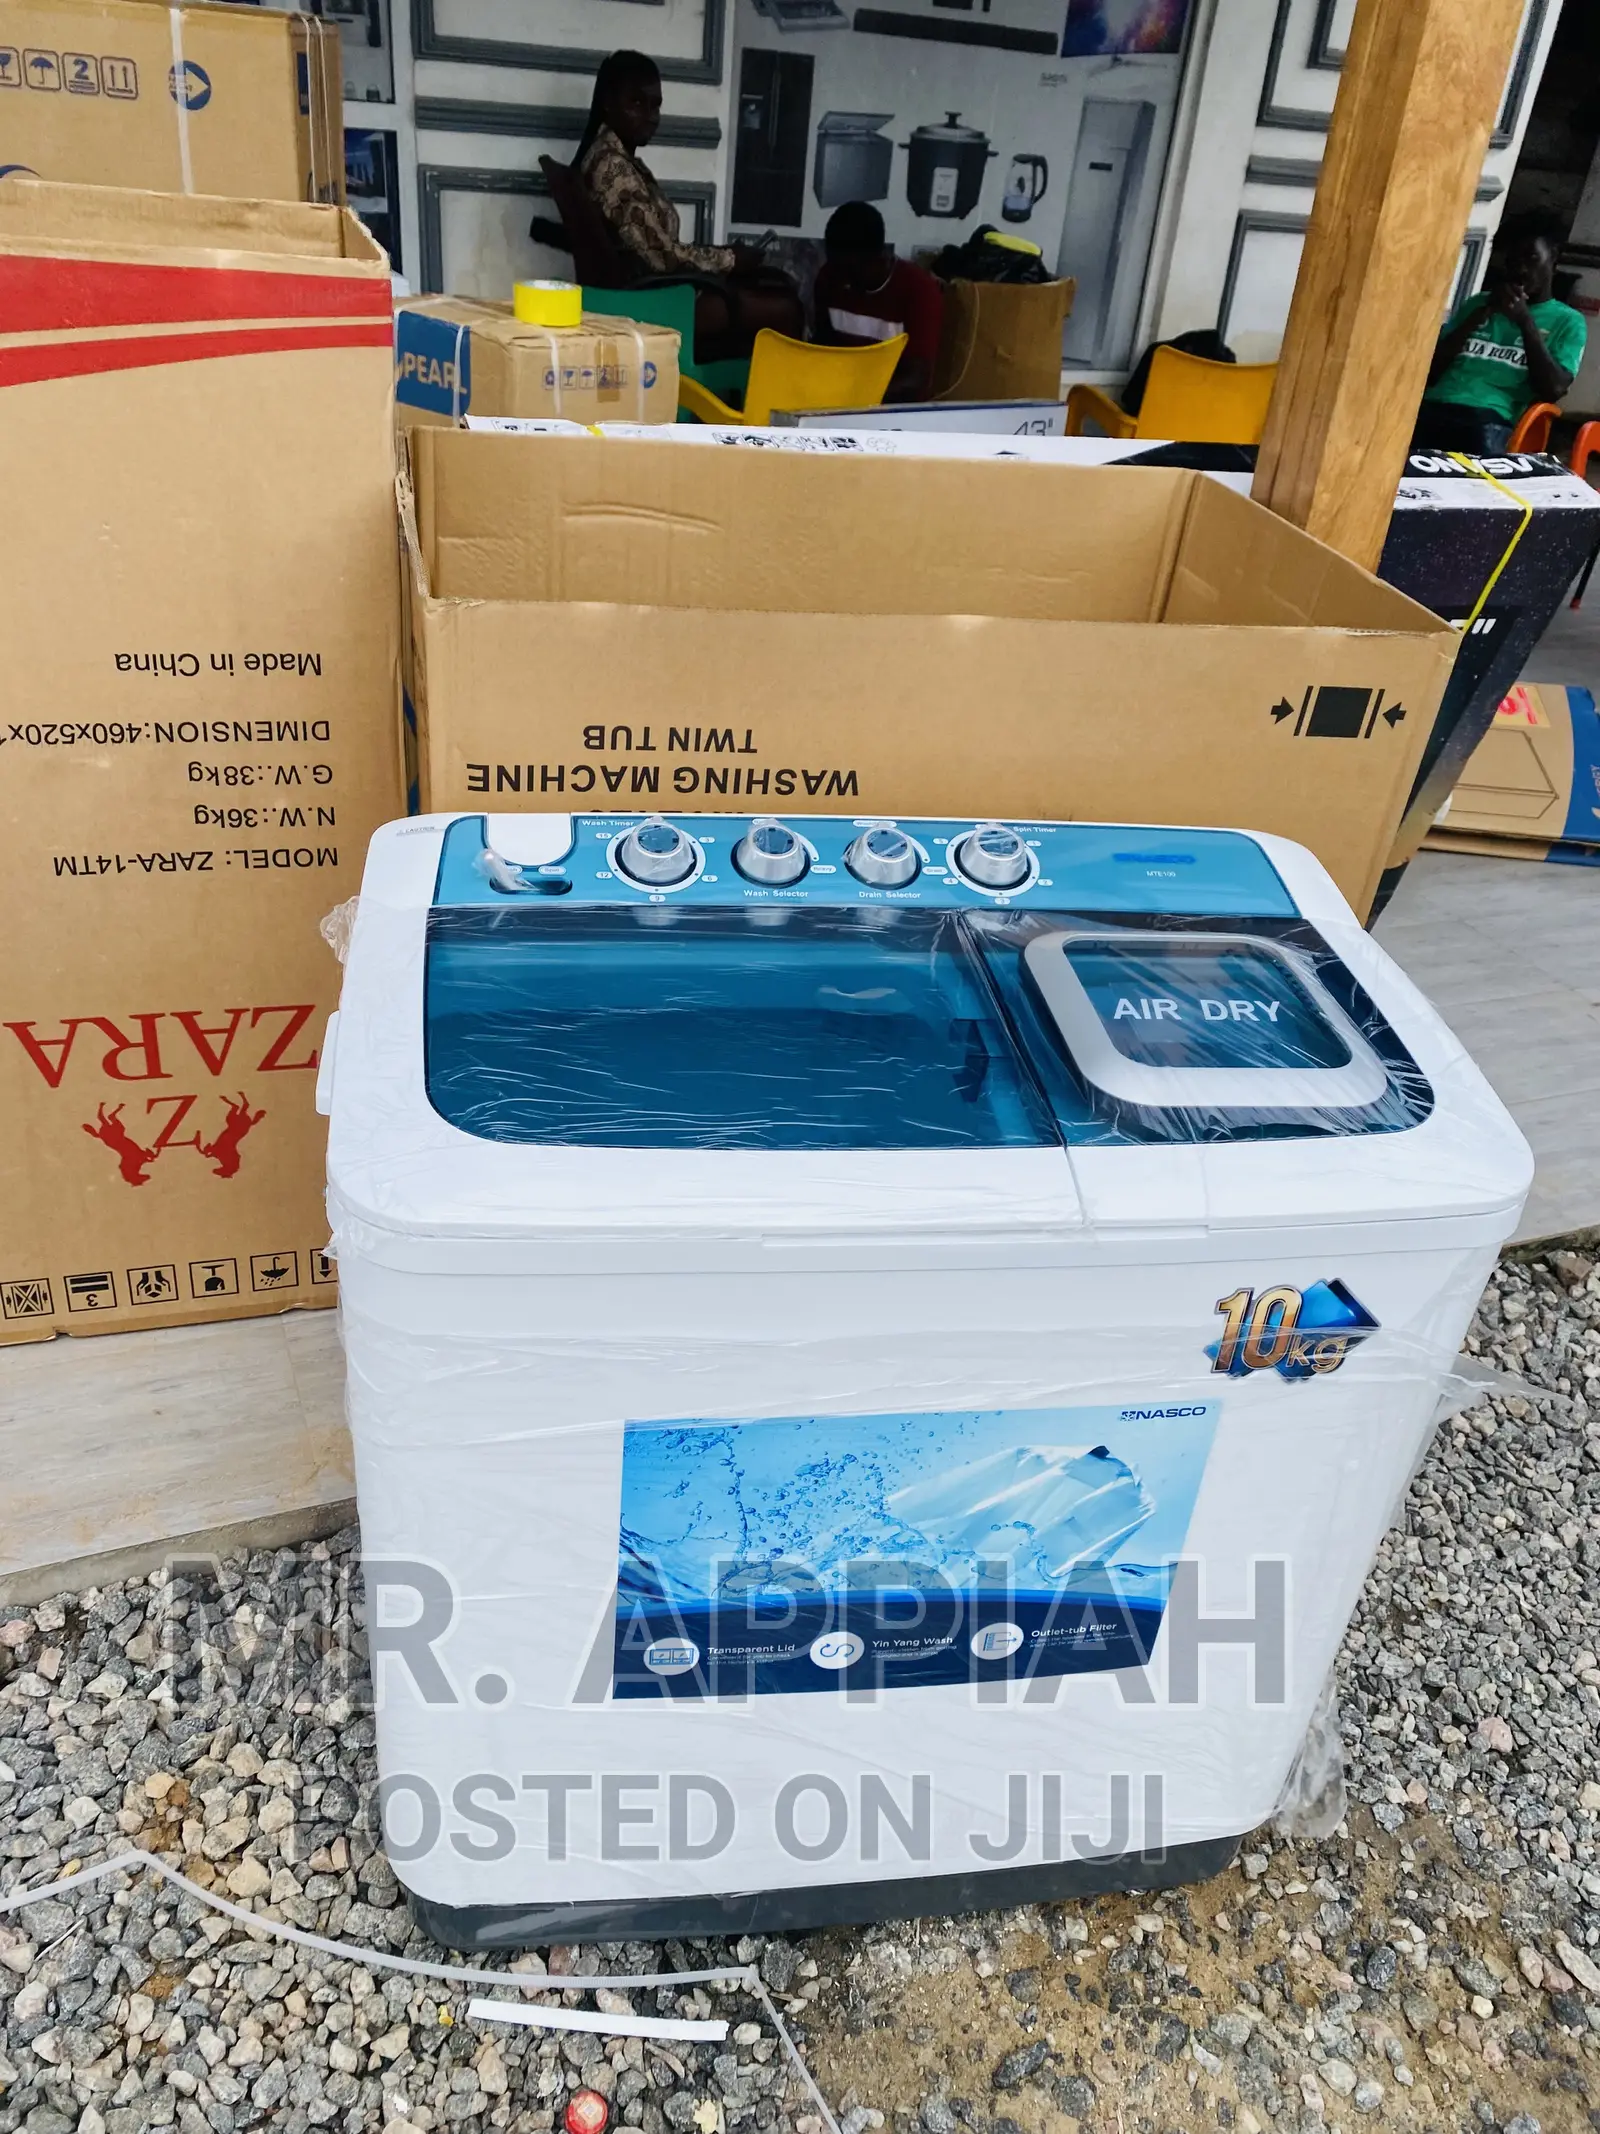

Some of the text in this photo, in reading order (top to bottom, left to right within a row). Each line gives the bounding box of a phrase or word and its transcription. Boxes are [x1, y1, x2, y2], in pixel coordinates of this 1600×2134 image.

[113, 653, 322, 678] Made in China
[581, 724, 758, 754] TWIN TUB
[187, 761, 333, 787] G.W.:38kg
[465, 762, 859, 797] WASHING MACHINE
[193, 804, 336, 829] N.W.:36kg
[582, 819, 635, 827] Wash Timer
[1013, 826, 1057, 834] Spin Timer
[53, 846, 339, 877] MODEL: ZARA-14TM
[743, 889, 809, 898] Wash Selector
[858, 890, 922, 900] Drain Selector
[1113, 998, 1280, 1022] AIR DRY
[2, 1003, 318, 1090] ZARA
[85, 1293, 99, 1308] 3
[1211, 1284, 1350, 1374] 10kg
[1134, 1406, 1207, 1422] NASCO
[1030, 1622, 1118, 1638] Outlet-tub Filter
[707, 1643, 796, 1656] Transparent Lid
[872, 1636, 954, 1648] Yin Yang Wash
